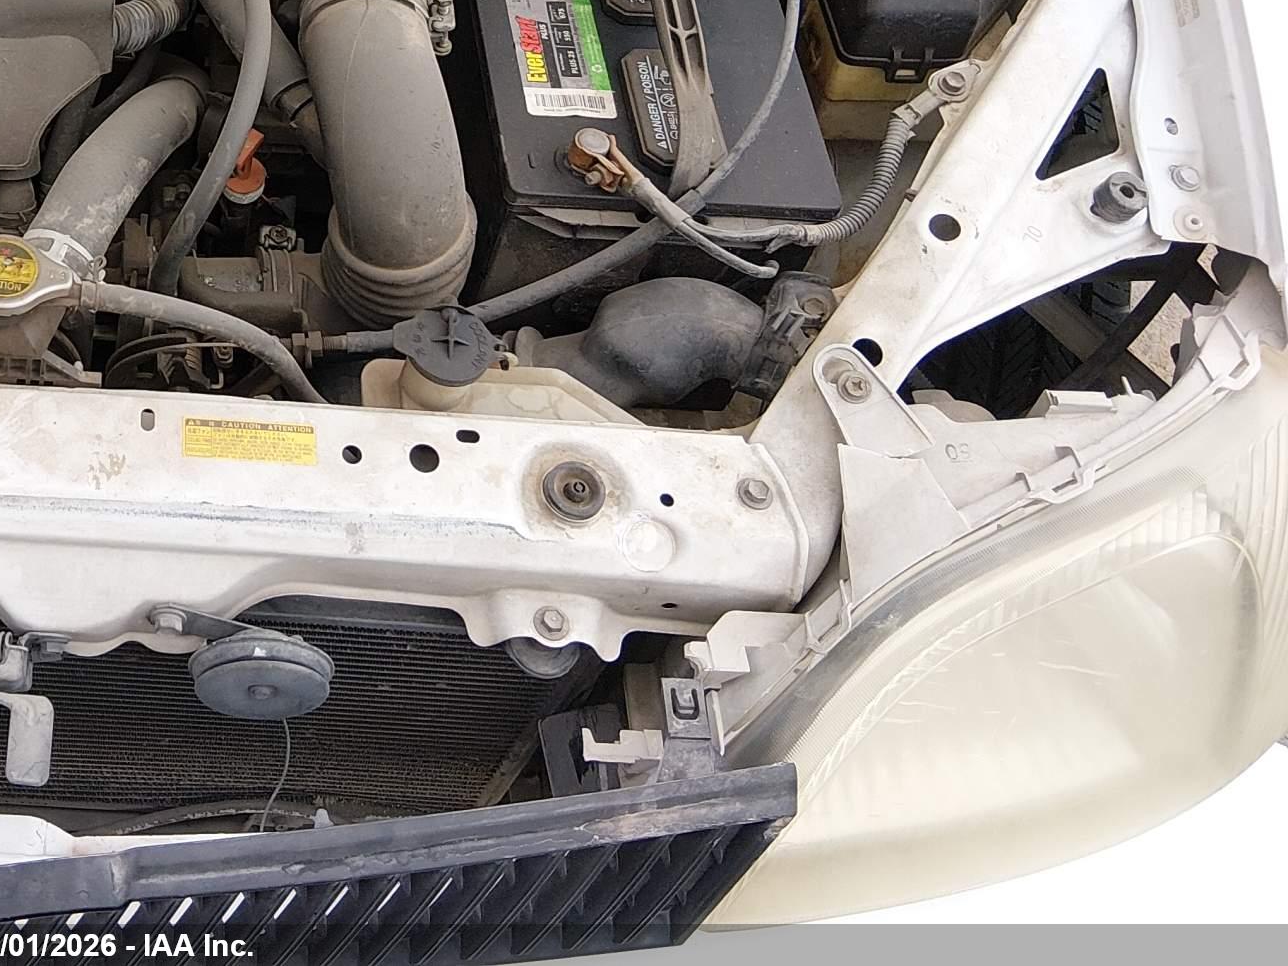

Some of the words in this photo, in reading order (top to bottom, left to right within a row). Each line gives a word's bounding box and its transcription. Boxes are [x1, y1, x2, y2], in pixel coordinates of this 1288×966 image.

[540, 24, 549, 40] PLUS
[514, 15, 549, 83] EverStart
[637, 62, 654, 94] POISON
[647, 102, 666, 140] DANGER
[221, 420, 262, 431] CAUTION
[267, 425, 313, 434] ATTENTION
